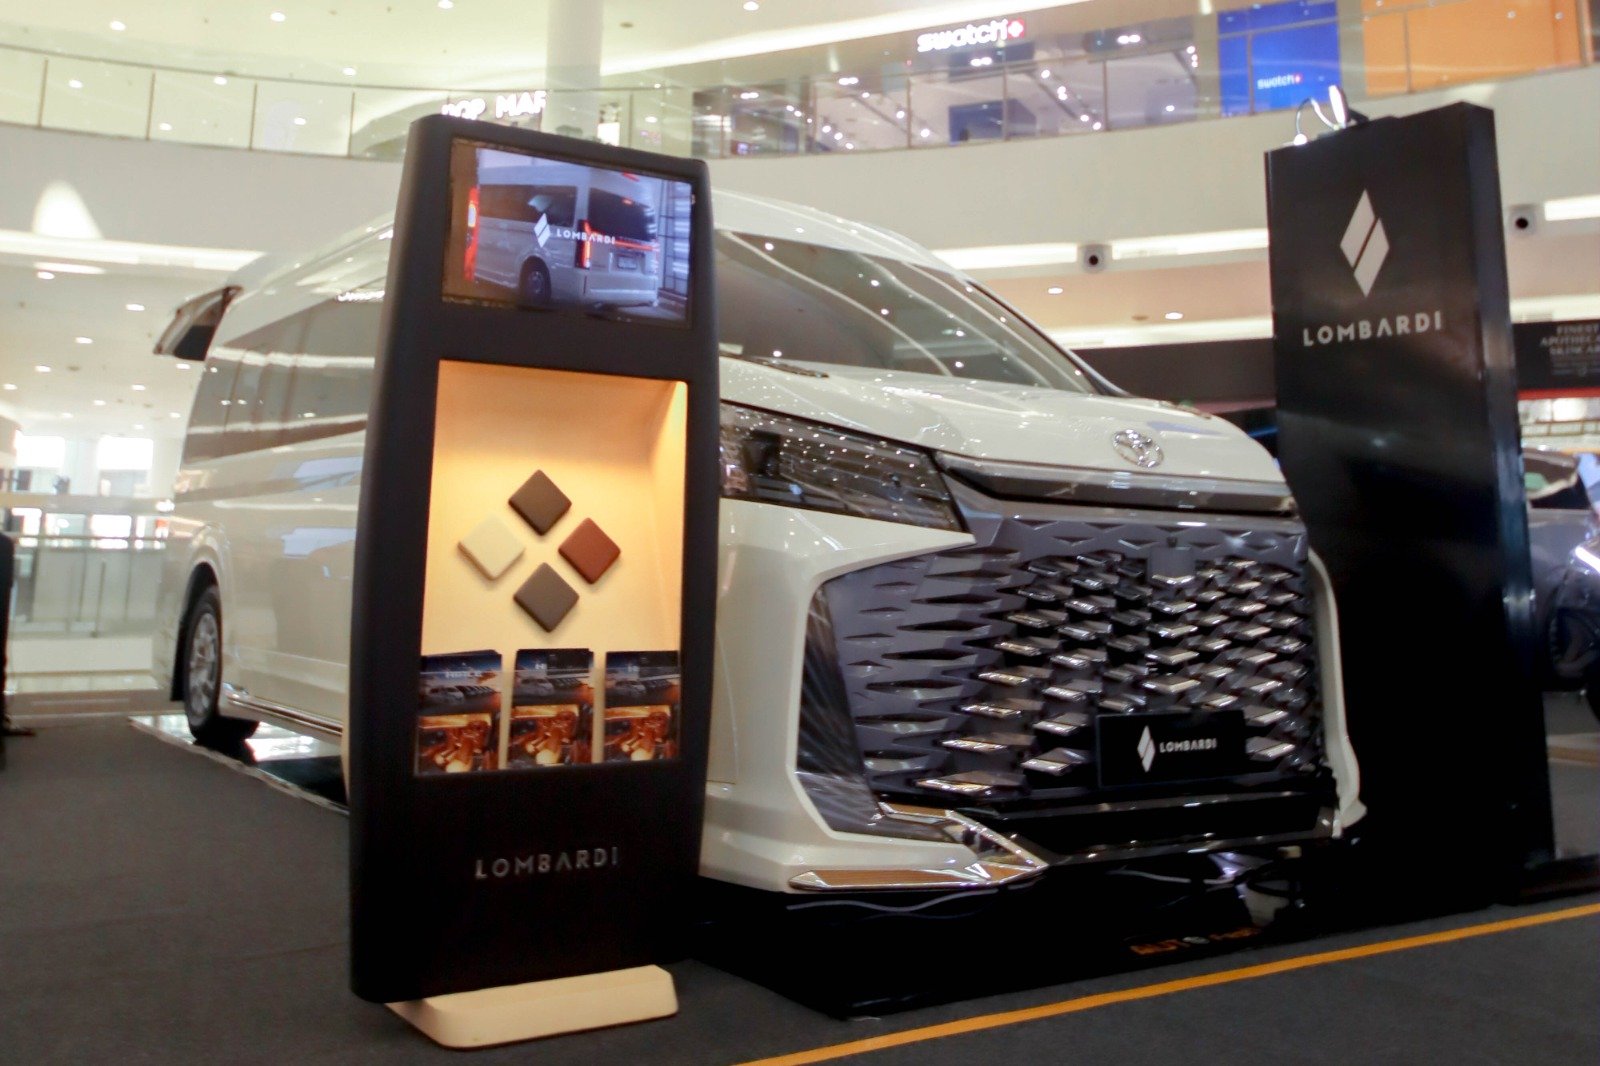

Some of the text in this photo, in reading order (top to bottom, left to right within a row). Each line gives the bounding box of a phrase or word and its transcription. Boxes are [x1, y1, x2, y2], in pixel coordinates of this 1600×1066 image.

[917, 19, 1007, 52] swatch
[1257, 75, 1294, 89] swatch
[556, 228, 615, 245] LOMBARDI
[1304, 311, 1441, 347] LOMBARDI
[1160, 738, 1217, 753] LOMBARDI
[475, 847, 619, 880] LOMBARDI
